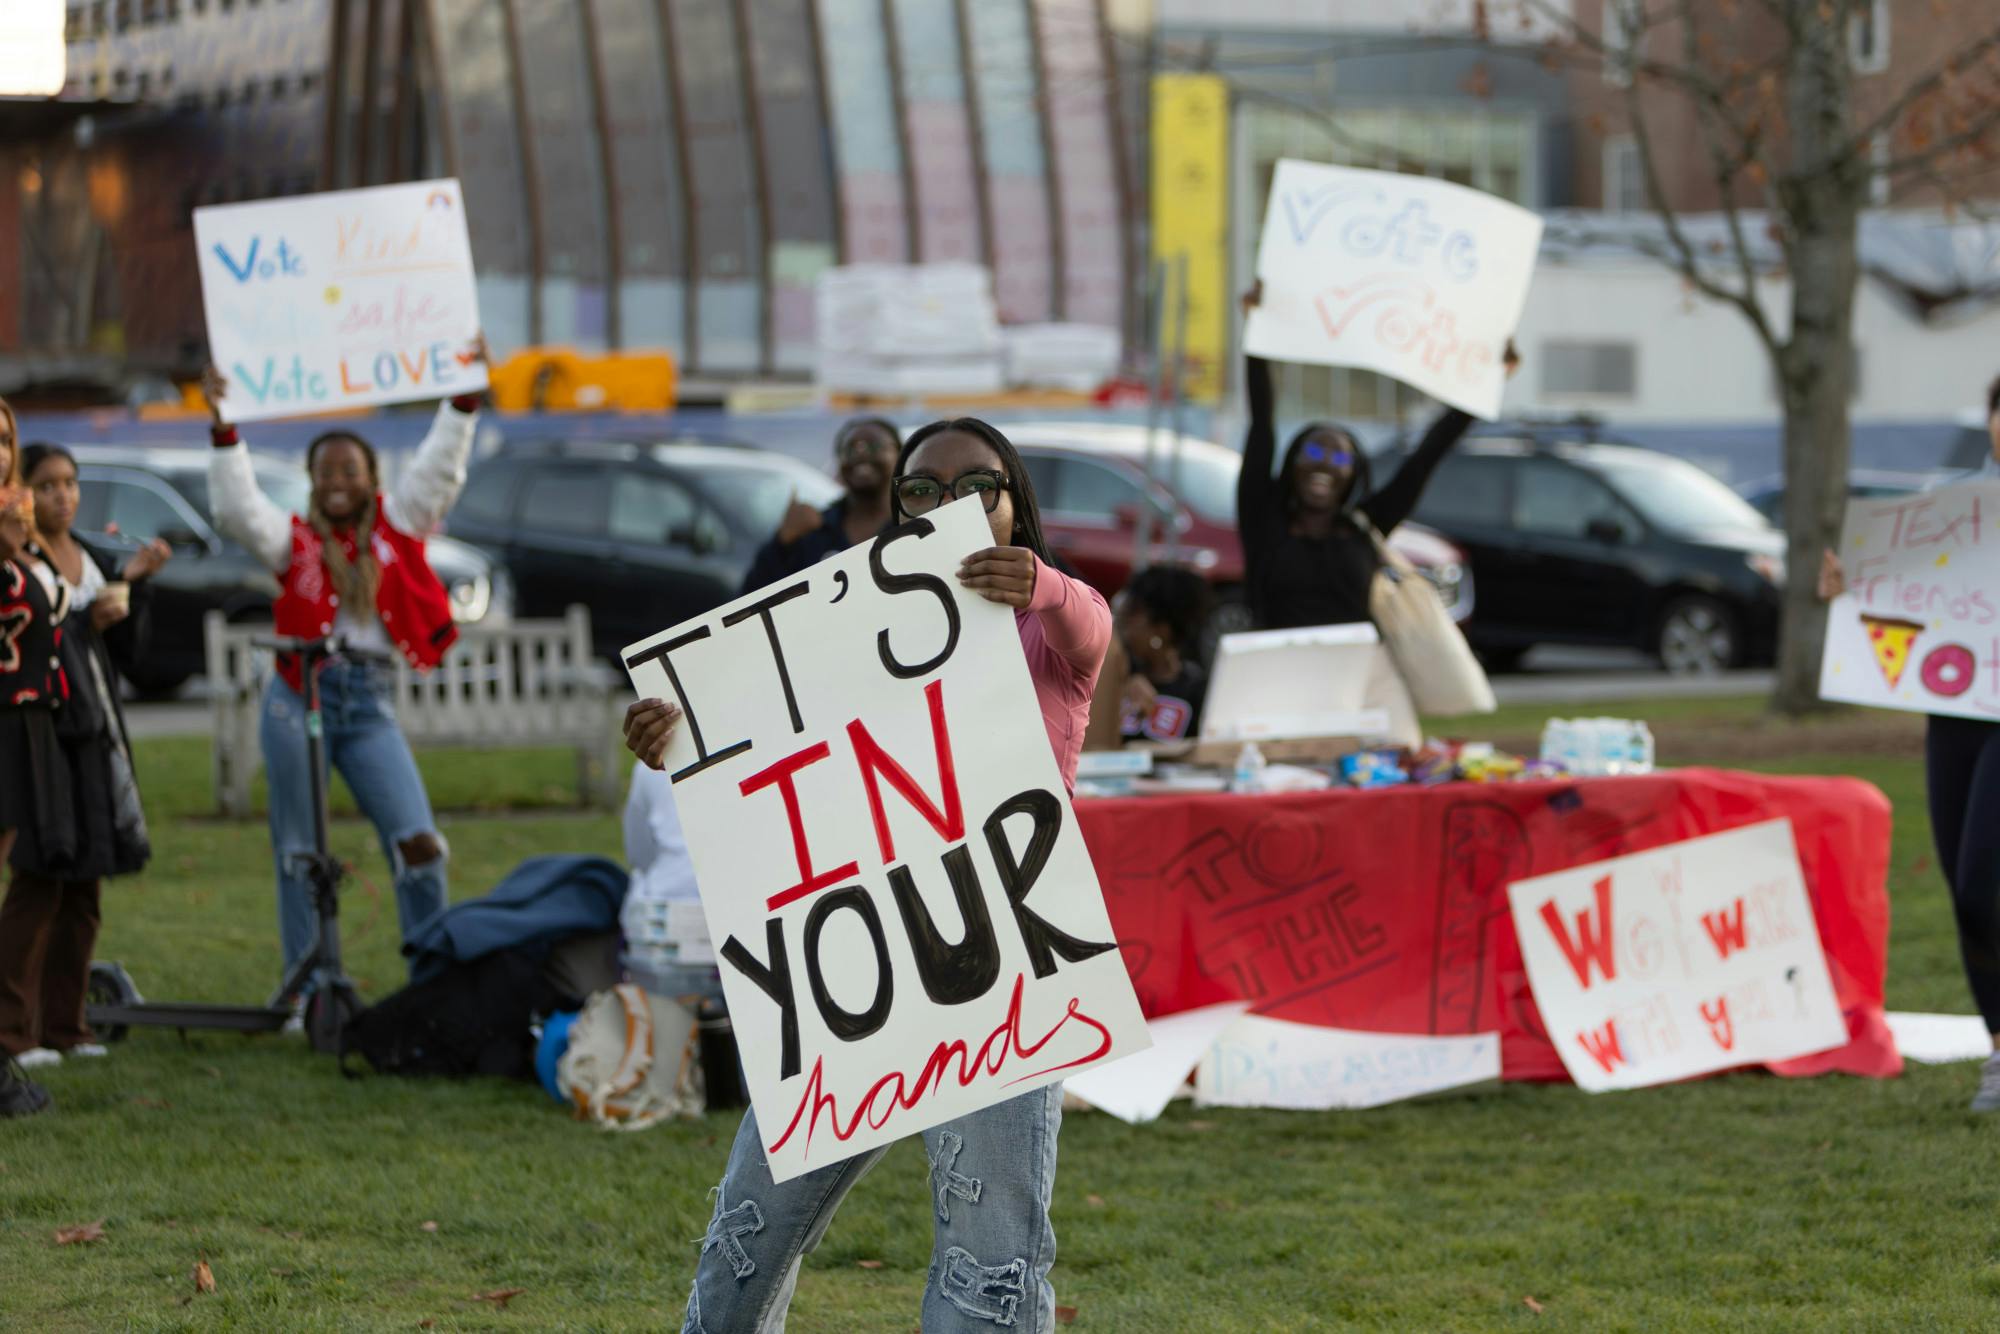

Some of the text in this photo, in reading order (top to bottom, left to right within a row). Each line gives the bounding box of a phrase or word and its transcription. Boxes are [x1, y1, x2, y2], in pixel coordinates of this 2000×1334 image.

[211, 235, 307, 284] Vote
[1284, 177, 1481, 283] Vote
[232, 341, 453, 405] Vote LOVE
[1312, 272, 1493, 383] Vote
[627, 518, 960, 784] IT'S
[739, 679, 965, 912] IN
[1158, 814, 1327, 903] TO
[720, 788, 1117, 1081] YOUR
[1197, 881, 1390, 999] THE
[769, 973, 1112, 1160] hands
